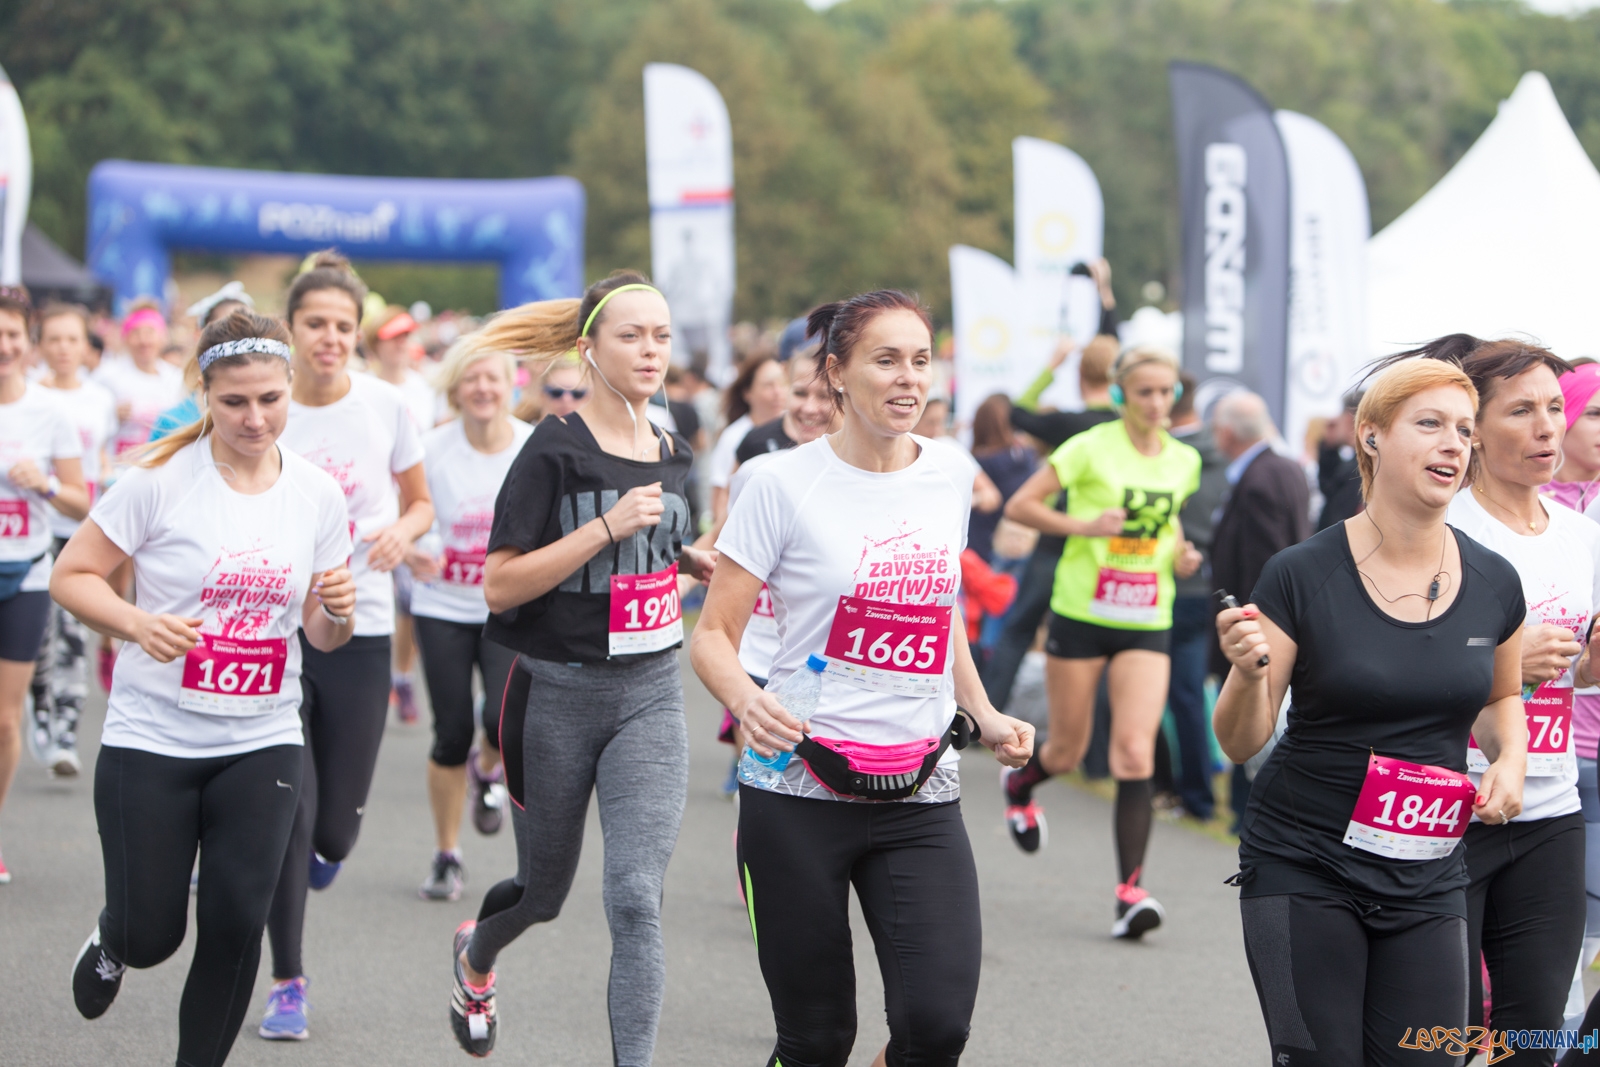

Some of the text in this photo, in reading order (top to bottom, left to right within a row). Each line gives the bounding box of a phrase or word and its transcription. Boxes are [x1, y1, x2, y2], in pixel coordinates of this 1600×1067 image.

[216, 573, 287, 589] zawsze
[869, 559, 947, 578] zawsze
[624, 589, 678, 628] 1920
[865, 610, 892, 620] Zawsze
[920, 616, 937, 624] 2016
[844, 627, 938, 669] 1665
[197, 659, 273, 693] 1671
[1372, 791, 1463, 833] 1844
